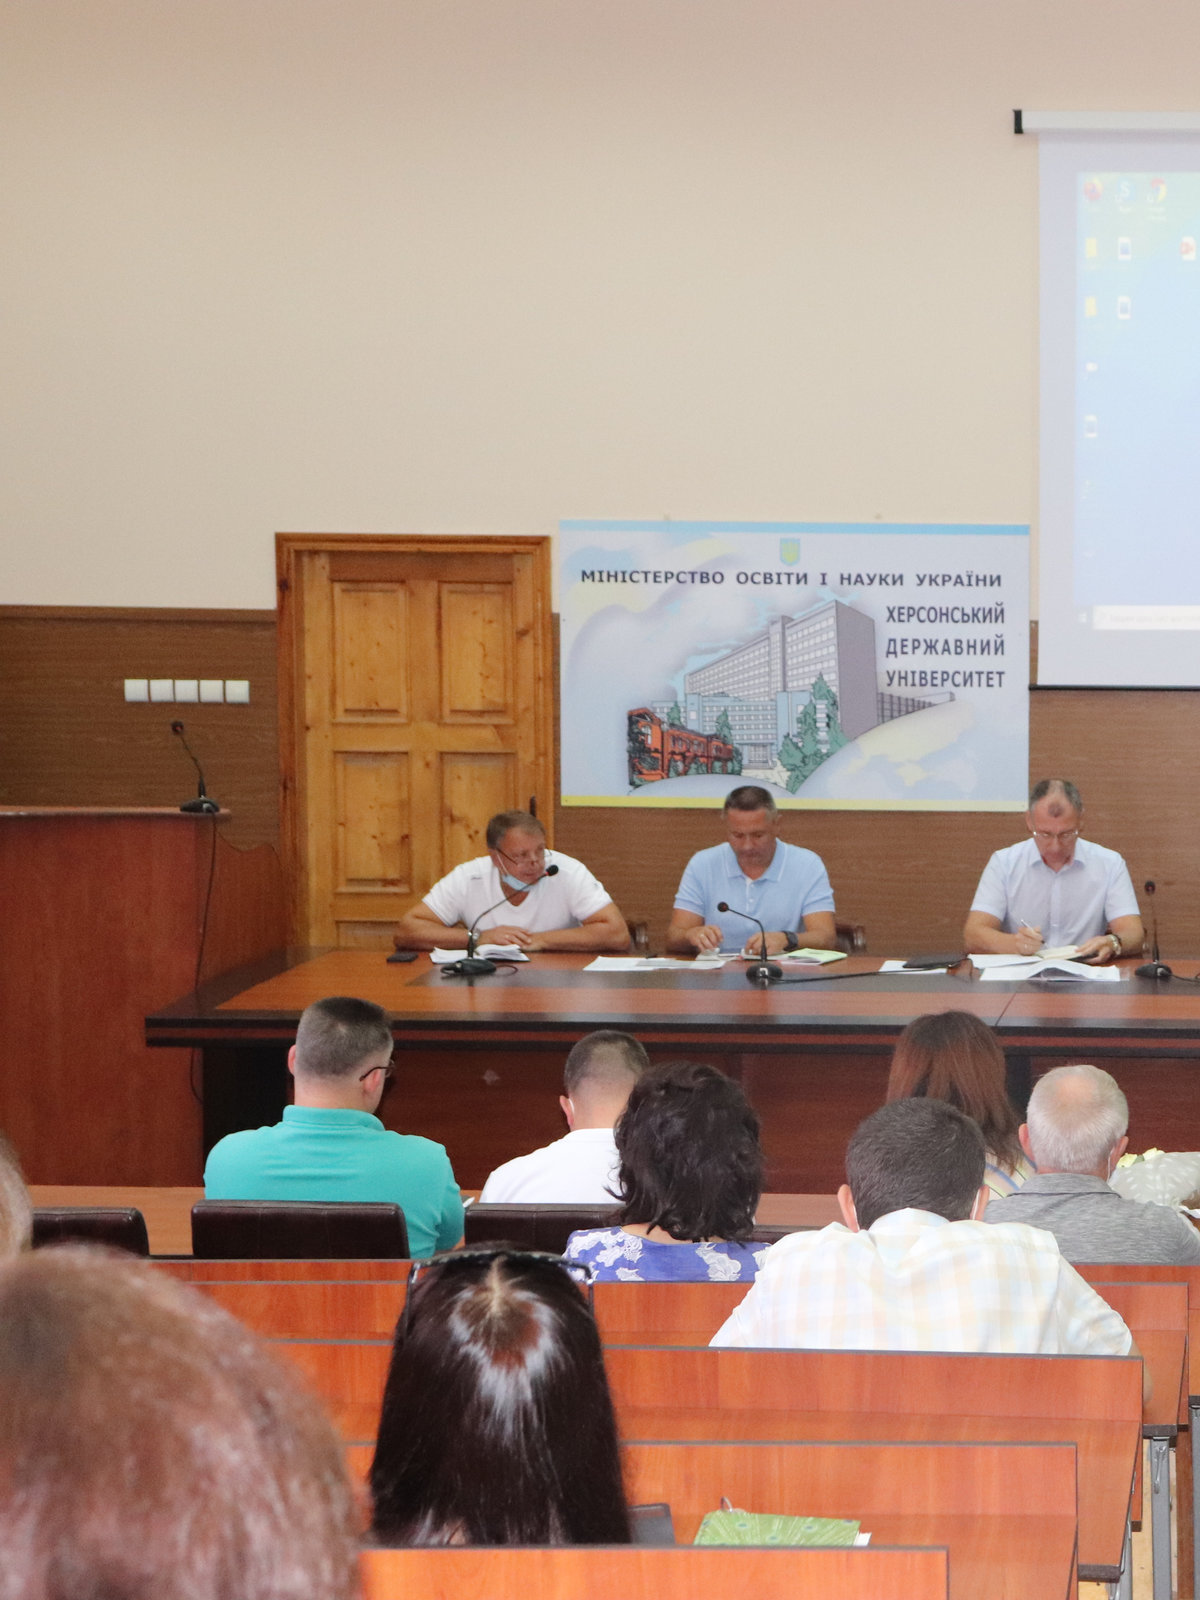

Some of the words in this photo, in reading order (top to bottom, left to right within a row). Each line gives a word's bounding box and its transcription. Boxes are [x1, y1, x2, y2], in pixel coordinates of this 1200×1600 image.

[581, 569, 725, 585] МІНІСТЕРСТВО
[736, 571, 808, 586] ОСВІТИ
[820, 572, 828, 586] І
[839, 573, 904, 587] НАУКИ
[916, 571, 1002, 588] УКРАЇНИ
[886, 602, 1005, 624] ХЕРСОНСЬКИЙ
[886, 634, 1005, 658] ДЕРЖАВНИЙ
[886, 670, 1005, 688] УНІВЕРСИТЕТ
